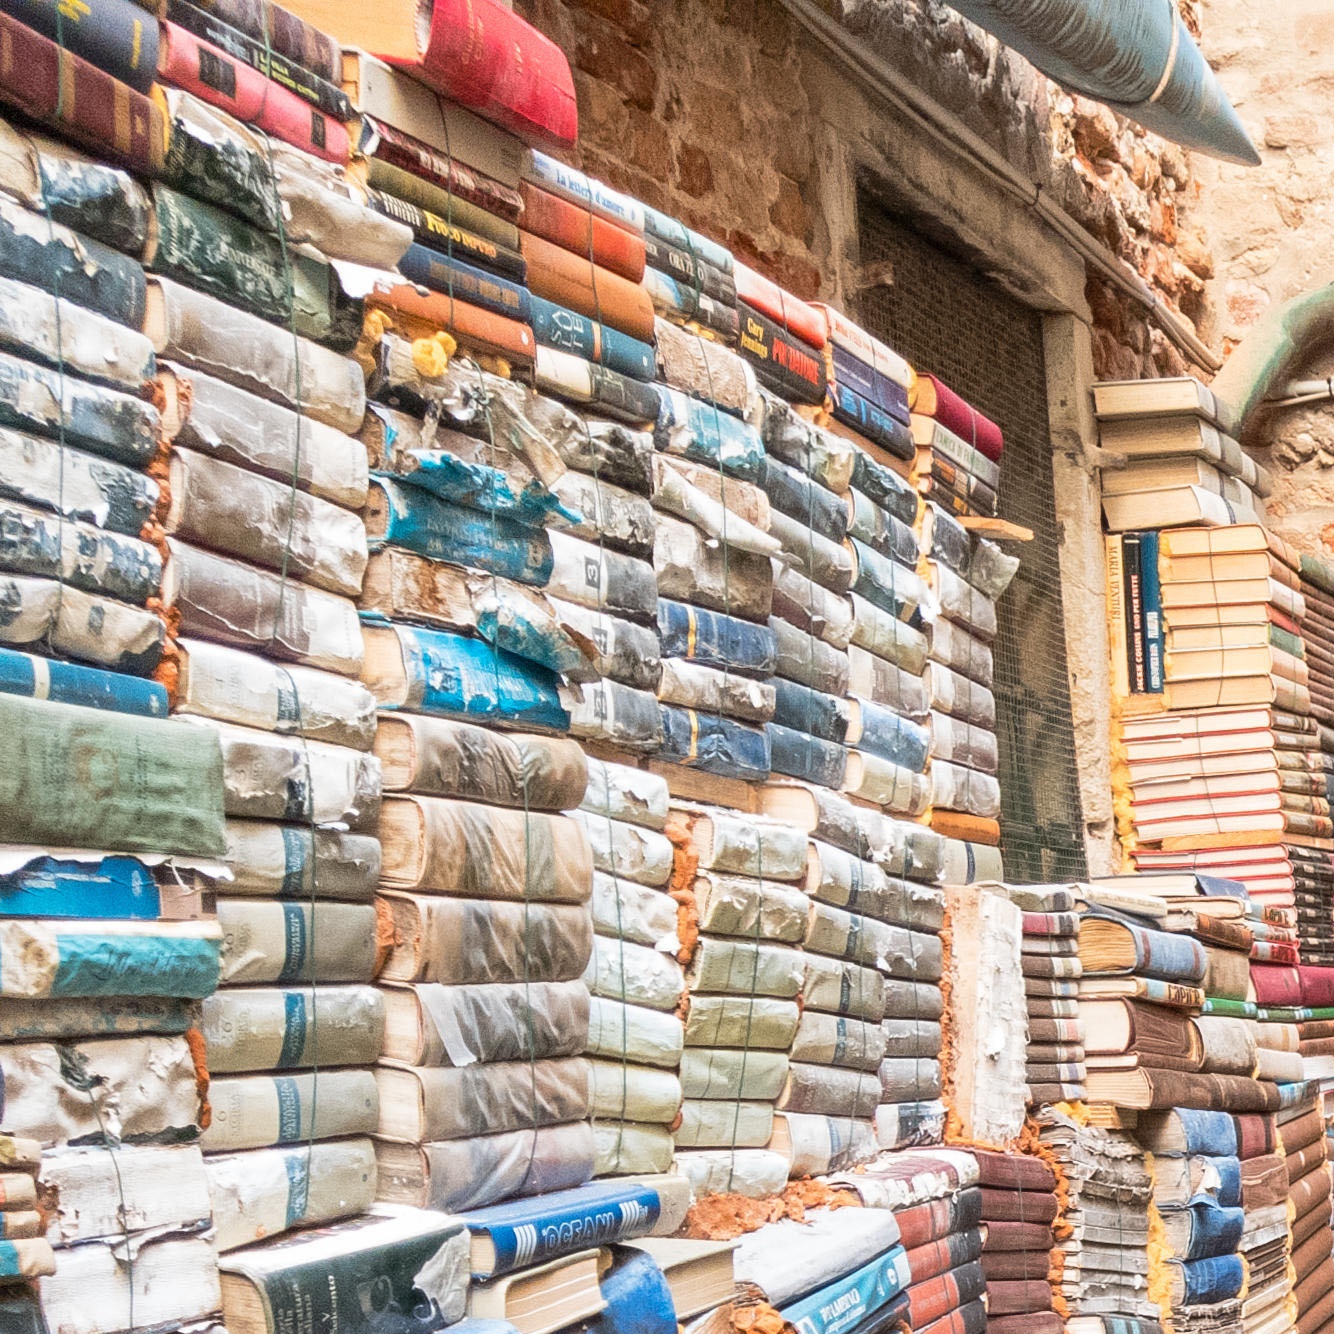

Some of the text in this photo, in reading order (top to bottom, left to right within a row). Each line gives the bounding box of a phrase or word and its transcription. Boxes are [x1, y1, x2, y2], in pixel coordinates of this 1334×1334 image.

[1110, 545, 1120, 620] MARIA VENTURI
[1134, 632, 1143, 663] COLLINS
[1135, 664, 1145, 691] JACKIE
